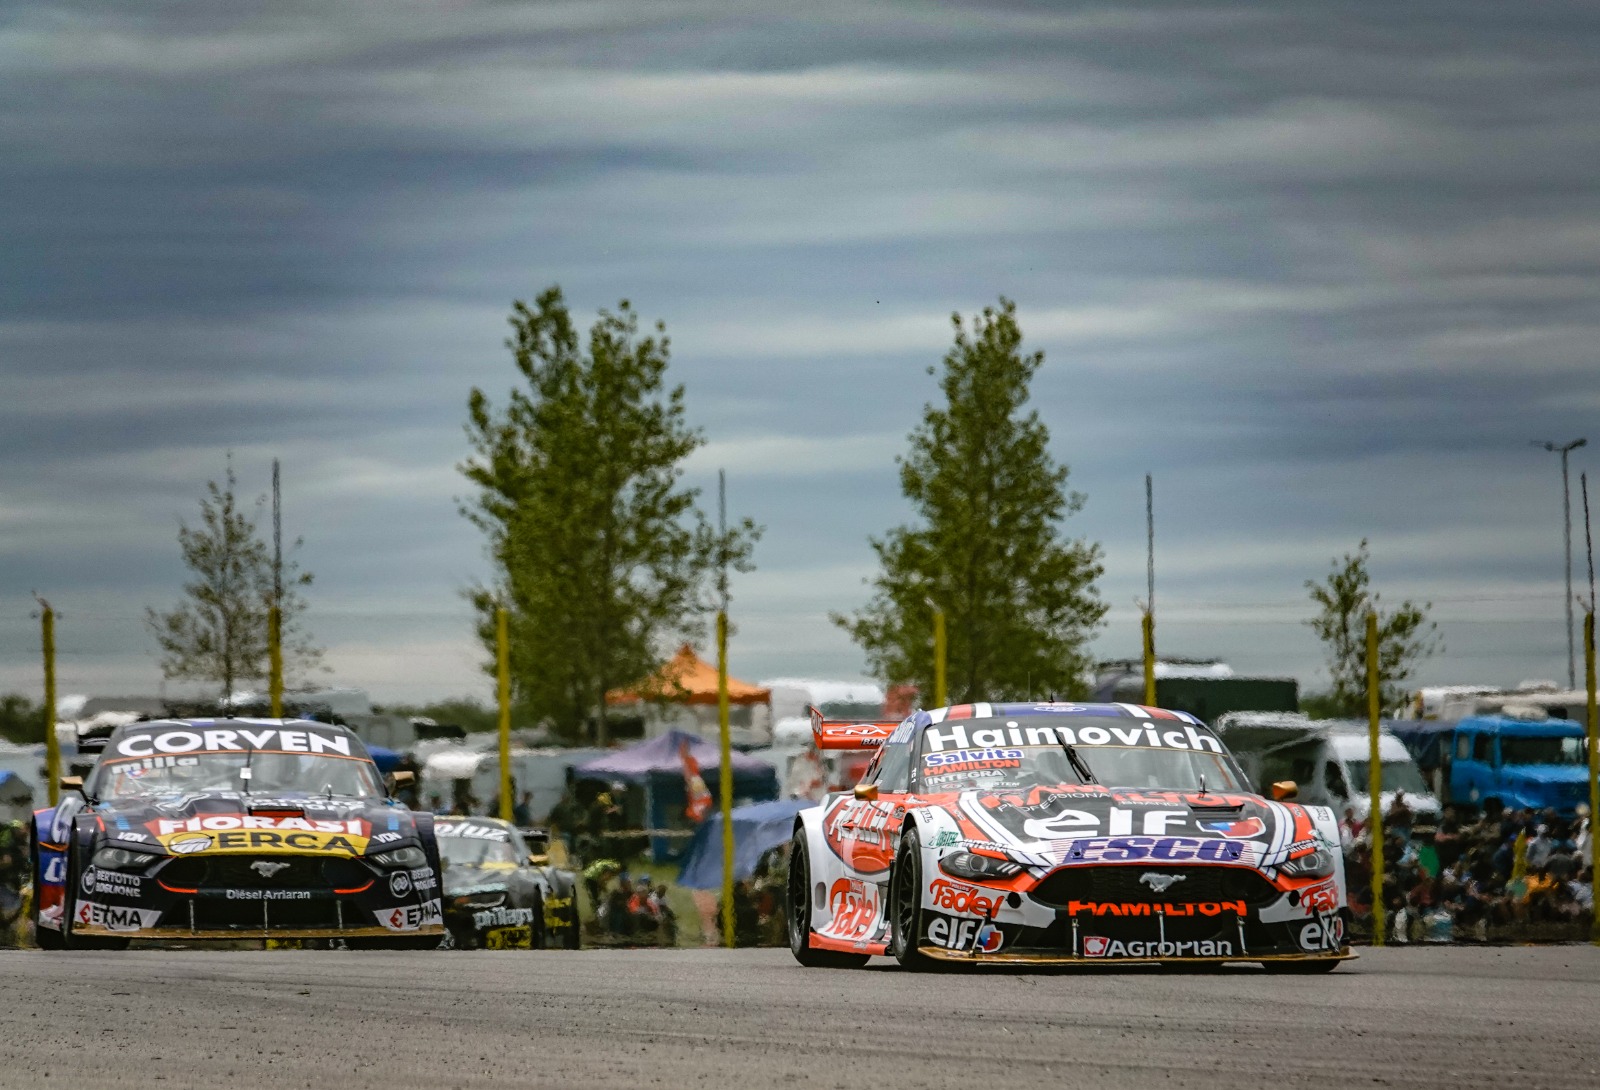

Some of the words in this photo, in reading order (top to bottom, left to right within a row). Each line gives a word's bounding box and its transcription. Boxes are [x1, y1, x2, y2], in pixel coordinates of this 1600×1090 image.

[117, 730, 350, 757] CORVEN
[926, 721, 1222, 754] Haimovich
[923, 759, 1020, 777] HAMILTON
[926, 749, 1022, 766] Salvita
[927, 769, 1005, 785] INTEGRA
[158, 815, 363, 837] FIORASI
[1024, 807, 1189, 839] elf
[218, 832, 360, 857] ERCA
[372, 832, 402, 844] VDN
[1062, 837, 1245, 864] ESCO
[929, 878, 1005, 919] Fadel
[1068, 900, 1248, 917] HAMILTON
[92, 904, 142, 929] ETMA
[928, 917, 976, 951] elf
